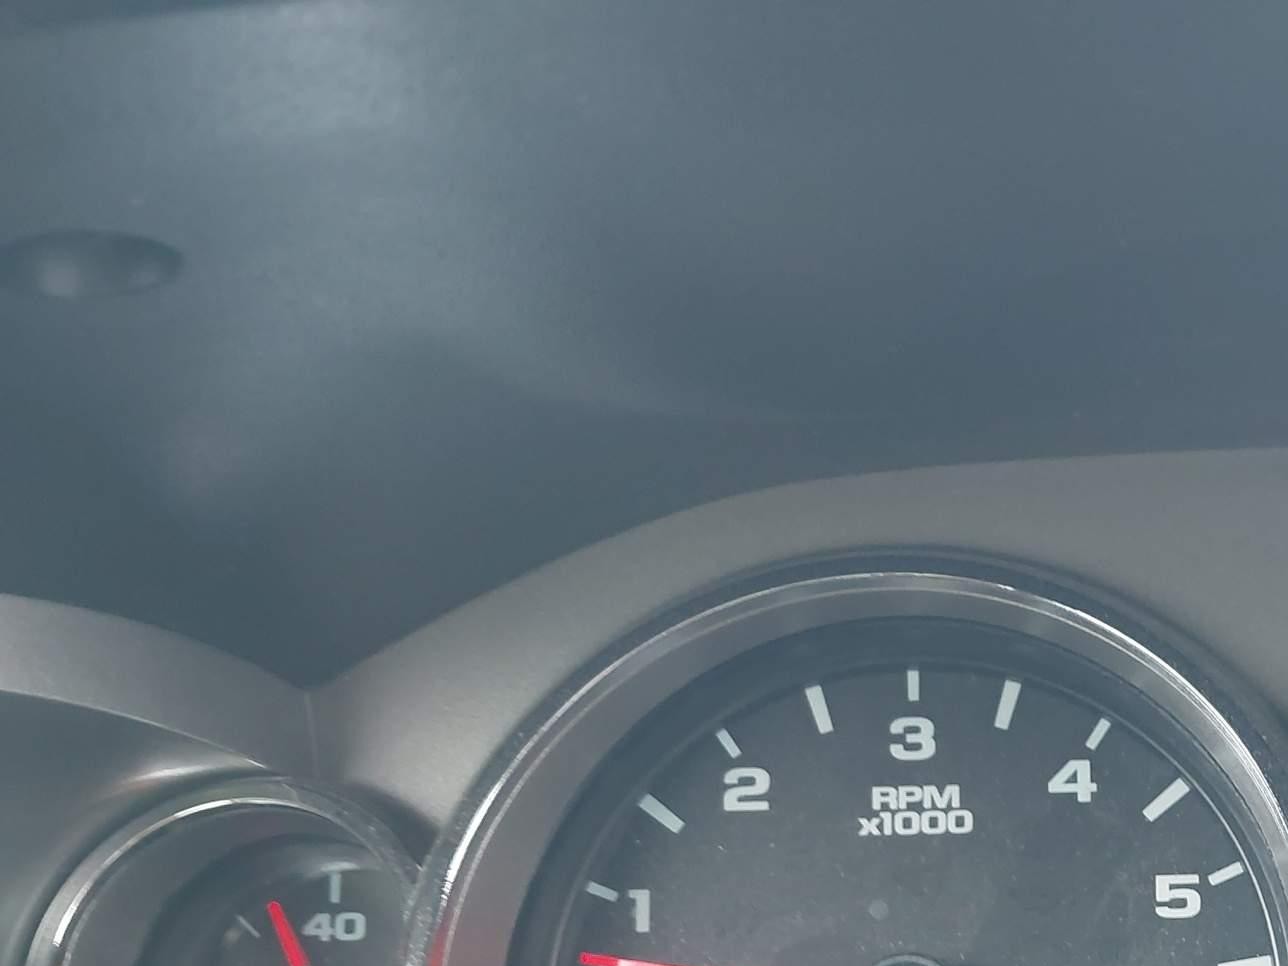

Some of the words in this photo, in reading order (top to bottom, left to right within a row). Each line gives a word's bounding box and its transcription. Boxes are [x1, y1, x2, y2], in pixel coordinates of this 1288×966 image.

[889, 716, 936, 761] 3
[722, 767, 771, 812] 2
[871, 784, 961, 810] RPM
[1047, 759, 1097, 803] 4
[857, 809, 974, 837] x1000
[628, 888, 651, 933] 1
[1154, 874, 1202, 919] 5
[302, 913, 367, 942] 40
